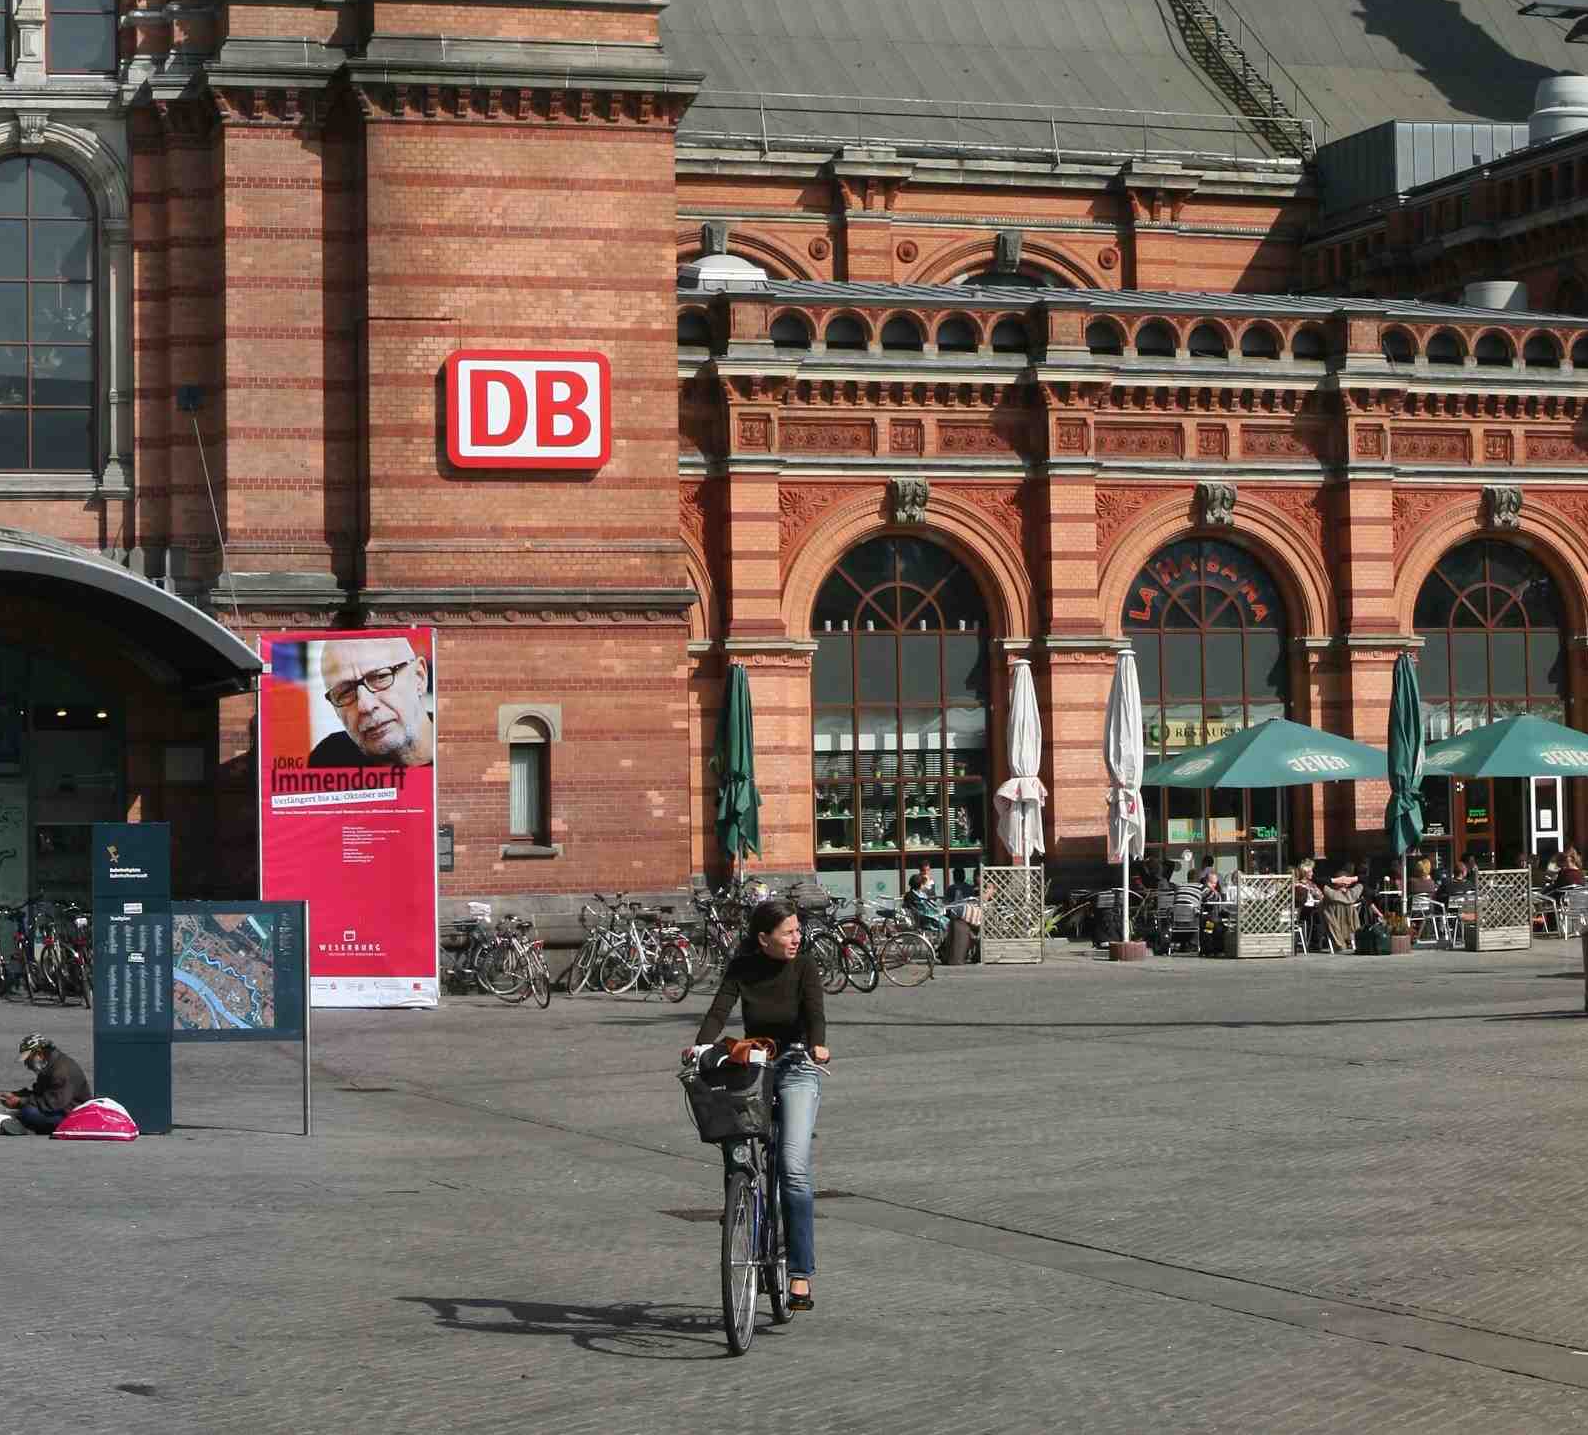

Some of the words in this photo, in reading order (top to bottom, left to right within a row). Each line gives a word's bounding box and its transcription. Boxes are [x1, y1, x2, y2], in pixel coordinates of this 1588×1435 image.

[469, 369, 592, 447] DB
[1128, 587, 1159, 621] LA
[271, 763, 406, 793] Immendorff
[1287, 753, 1351, 773] JEVER
